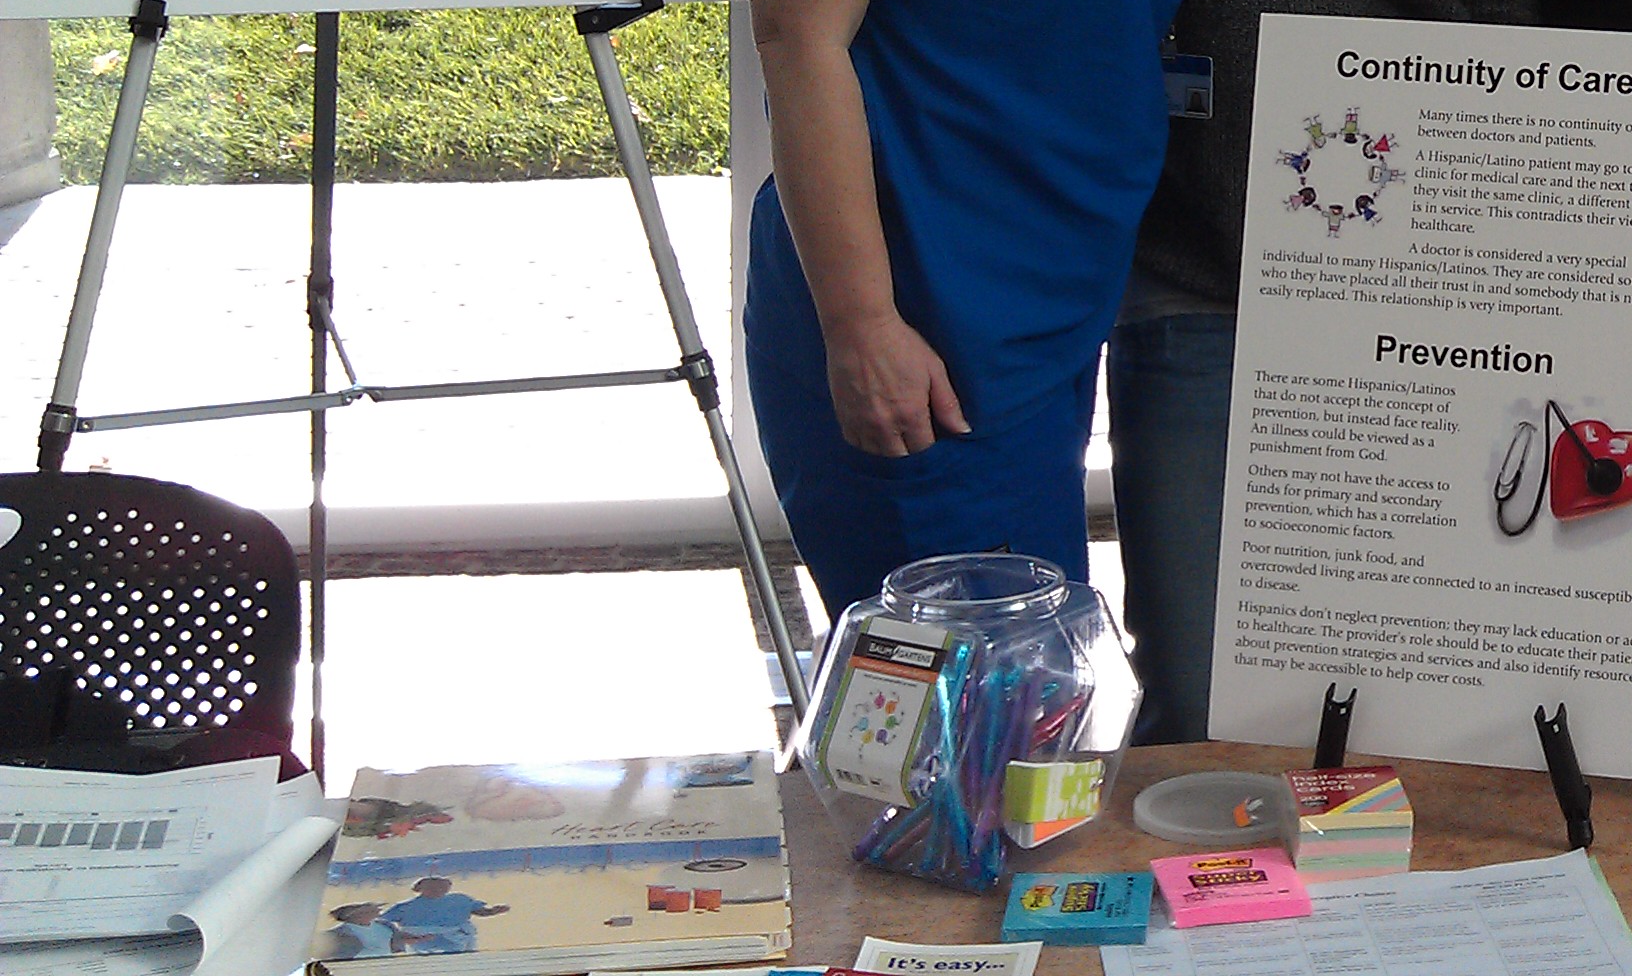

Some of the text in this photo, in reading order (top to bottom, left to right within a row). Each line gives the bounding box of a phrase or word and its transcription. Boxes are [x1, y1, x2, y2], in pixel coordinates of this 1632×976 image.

[1336, 50, 1505, 91] Continuity
[1515, 62, 1550, 89] of
[1418, 108, 1453, 124] Many
[1455, 112, 1489, 124] times
[1492, 112, 1523, 126] there
[1525, 117, 1536, 126] is
[1539, 118, 1556, 128] no
[1558, 117, 1622, 135] continuity
[1417, 125, 1596, 148] between doctors and patients.
[1375, 334, 1553, 375] Prevention
[1254, 370, 1456, 396] There are some Hispanics/Latinos
[1249, 442, 1388, 461] punishment from God.
[887, 957, 926, 971] It's
